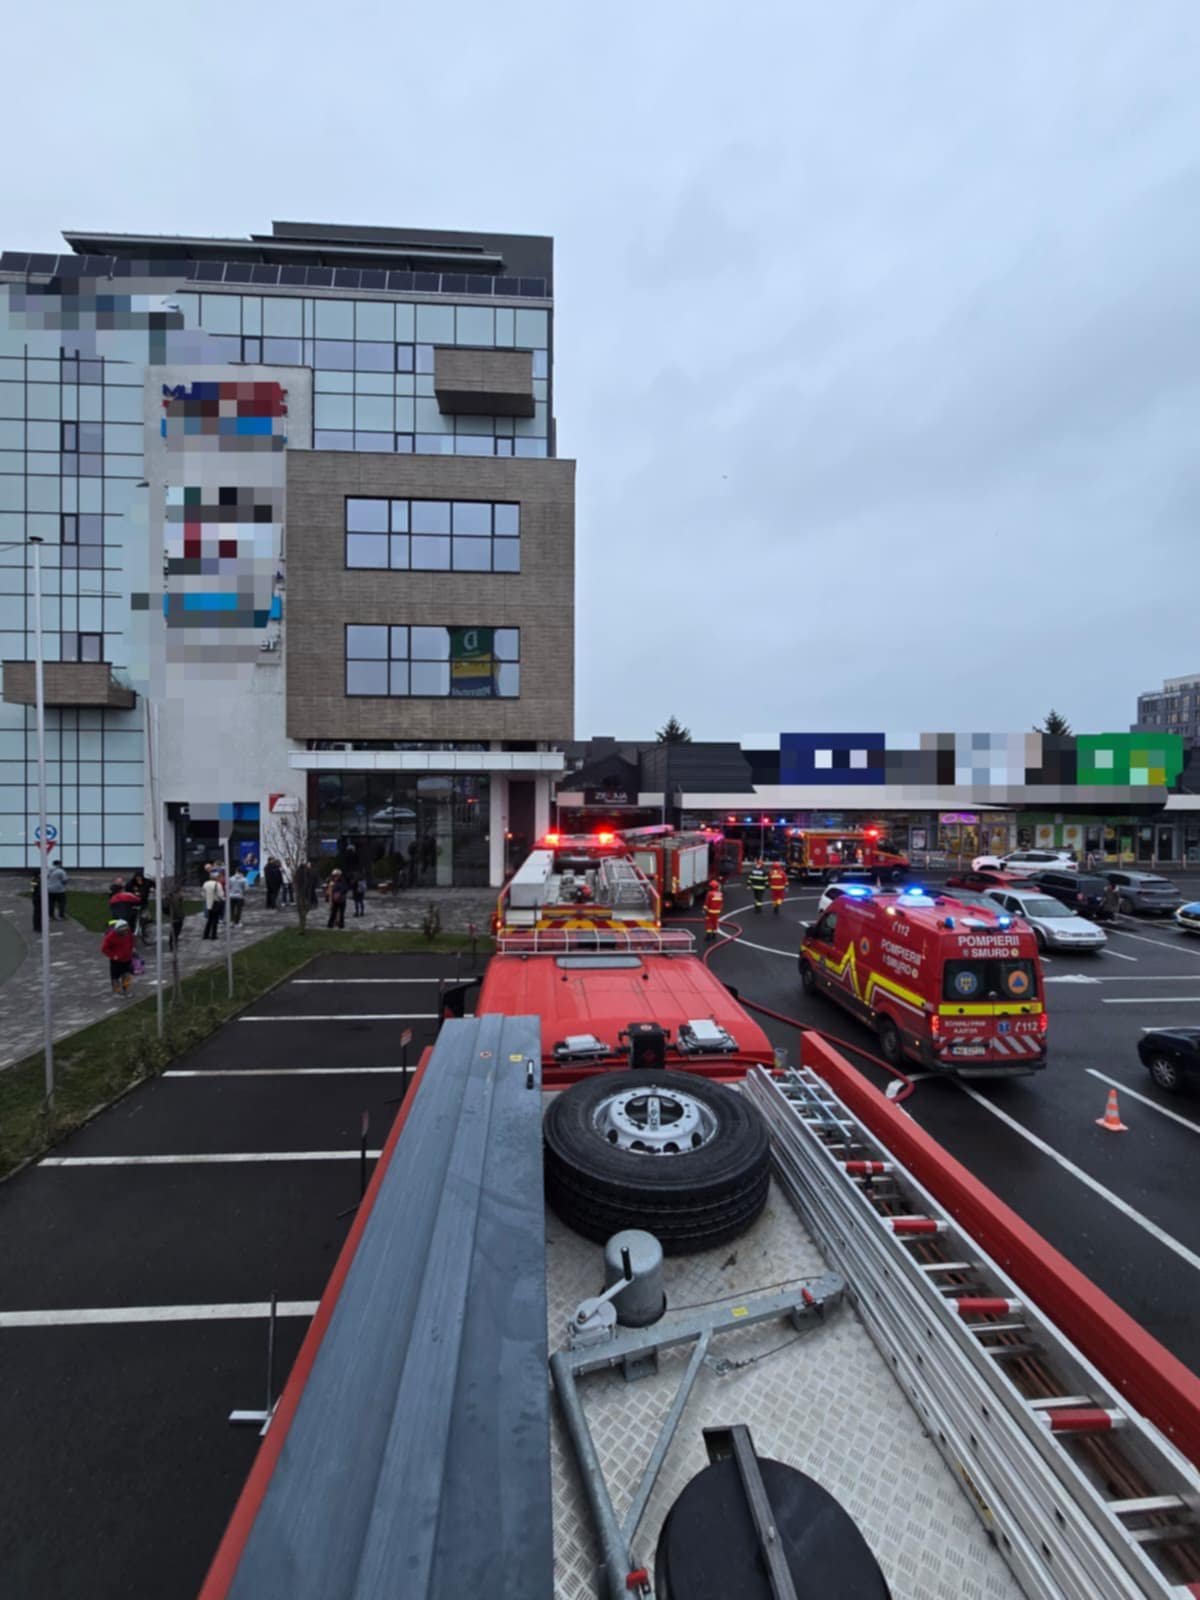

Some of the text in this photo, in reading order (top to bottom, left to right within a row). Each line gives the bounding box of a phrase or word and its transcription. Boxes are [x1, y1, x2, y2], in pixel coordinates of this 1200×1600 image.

[897, 924, 910, 936] 112
[958, 935, 1020, 946] POMPIERII
[971, 948, 1009, 958] SMURD
[1022, 1022, 1038, 1031] 112
